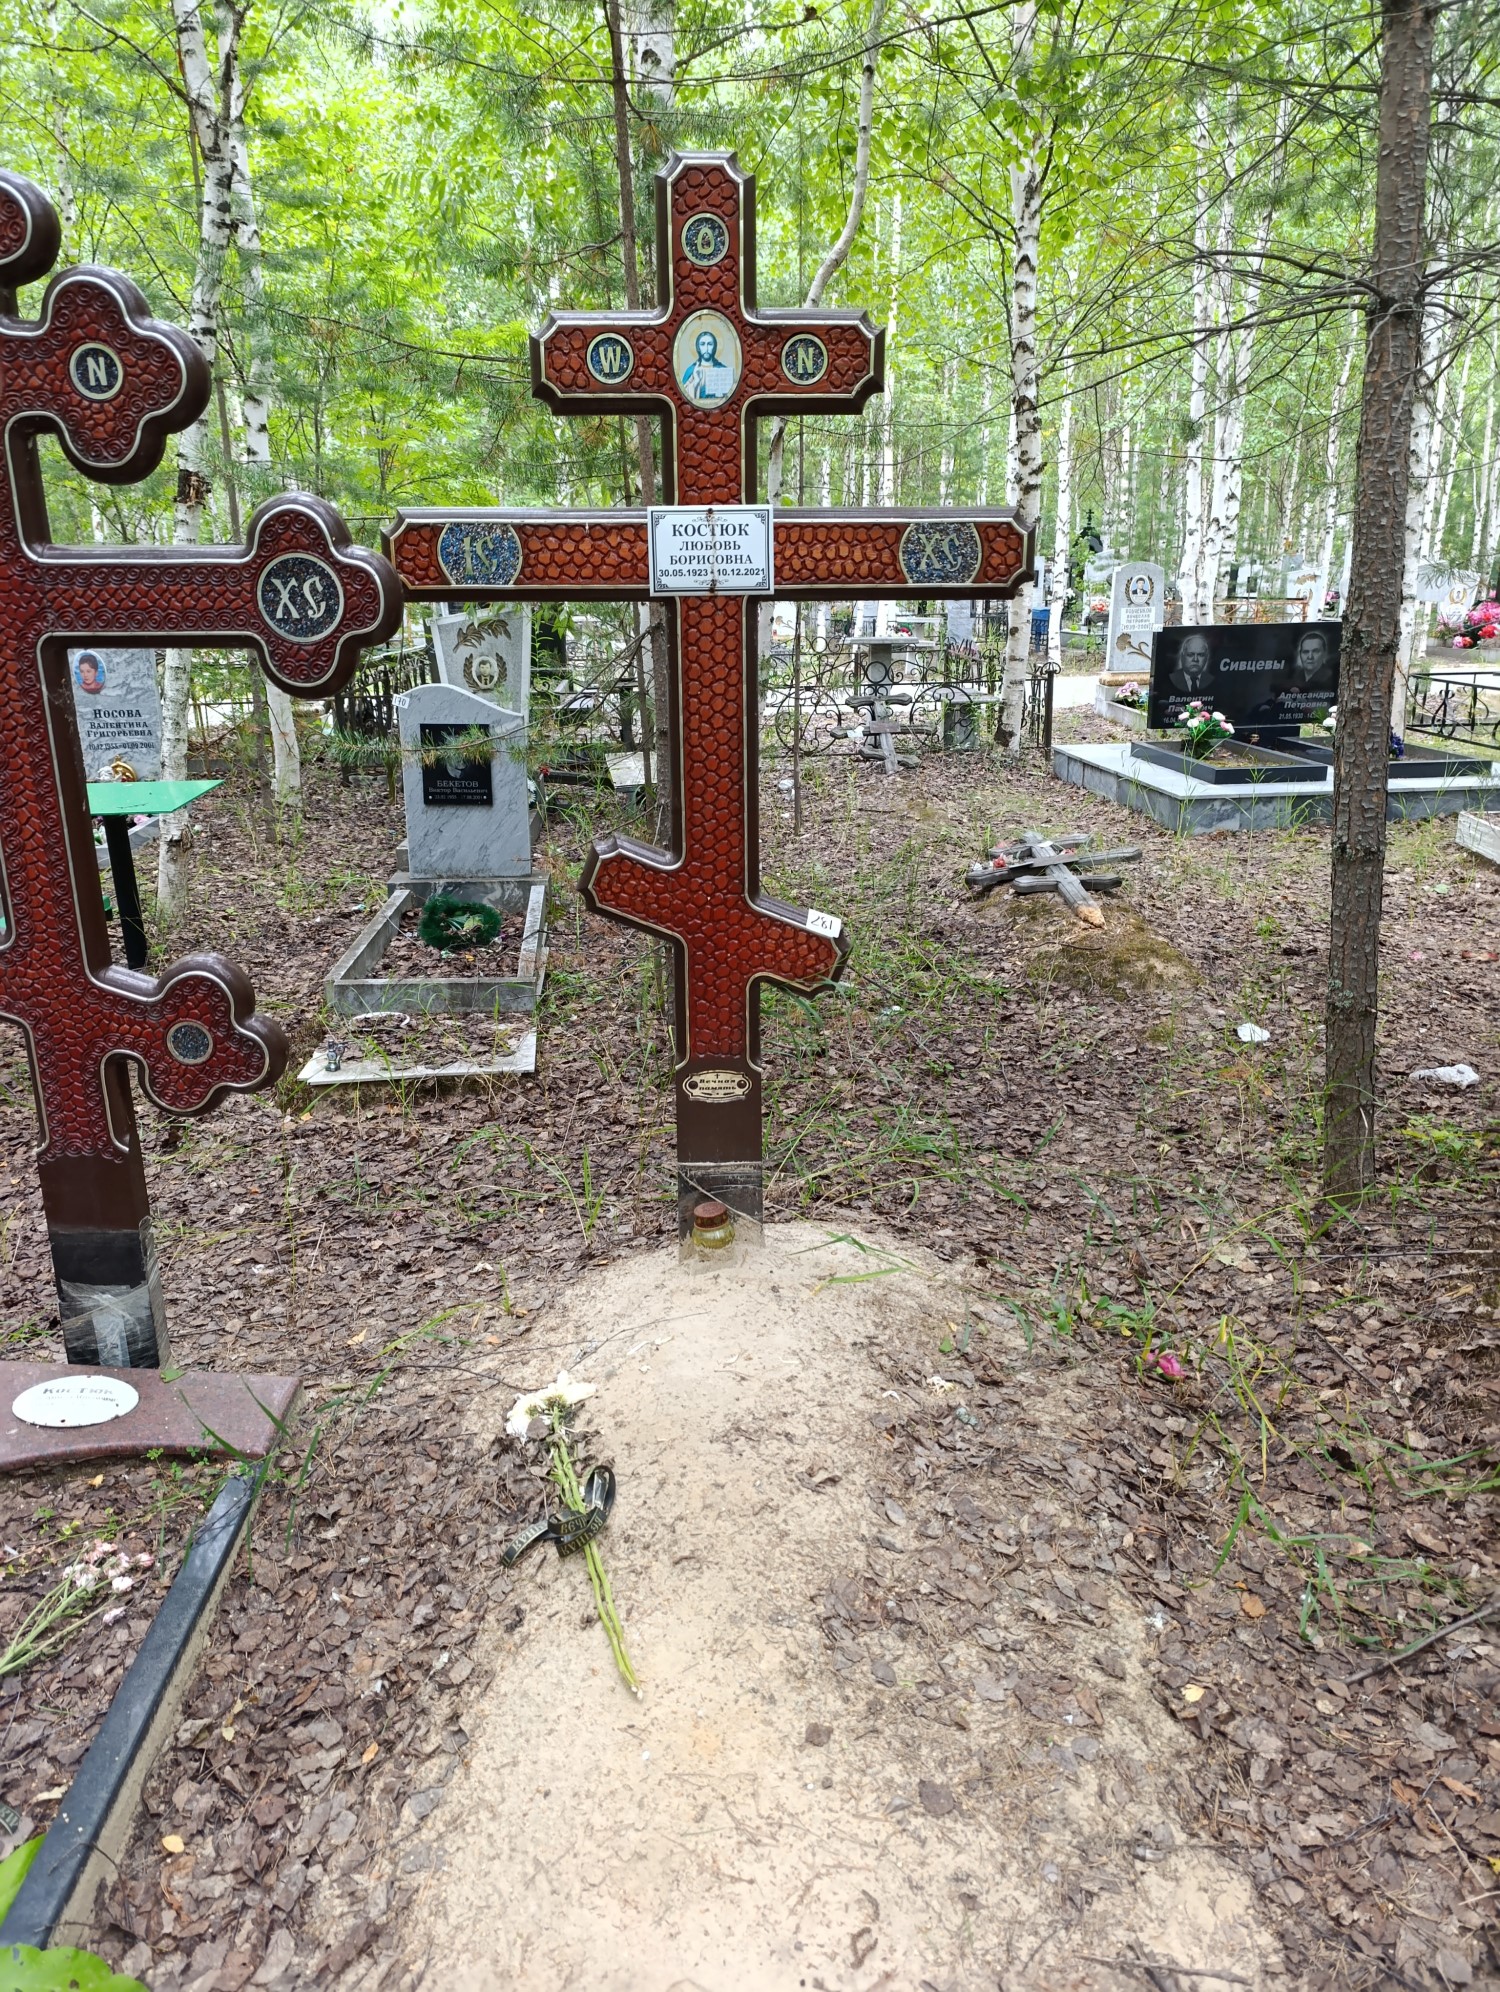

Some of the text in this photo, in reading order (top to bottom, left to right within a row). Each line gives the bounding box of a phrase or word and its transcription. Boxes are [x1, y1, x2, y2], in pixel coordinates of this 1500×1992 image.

[797, 347, 814, 374] N
[85, 356, 108, 387] N
[672, 523, 750, 537] КОСТЮК
[679, 540, 741, 551] ЛЮБОВЬ
[670, 554, 753, 565] БОРИСОВНА
[658, 568, 708, 577] 30.05.1923
[717, 567, 765, 577] 10.12.2021
[1219, 657, 1285, 673] Сивцевы
[1168, 695, 1215, 703] Валентин
[1283, 701, 1328, 709] Петровна
[90, 721, 149, 730] ВАЛЕНТИНА
[87, 730, 153, 738] ГРИГОРЬЕВНА
[436, 780, 479, 788] БЕКЕТОВ
